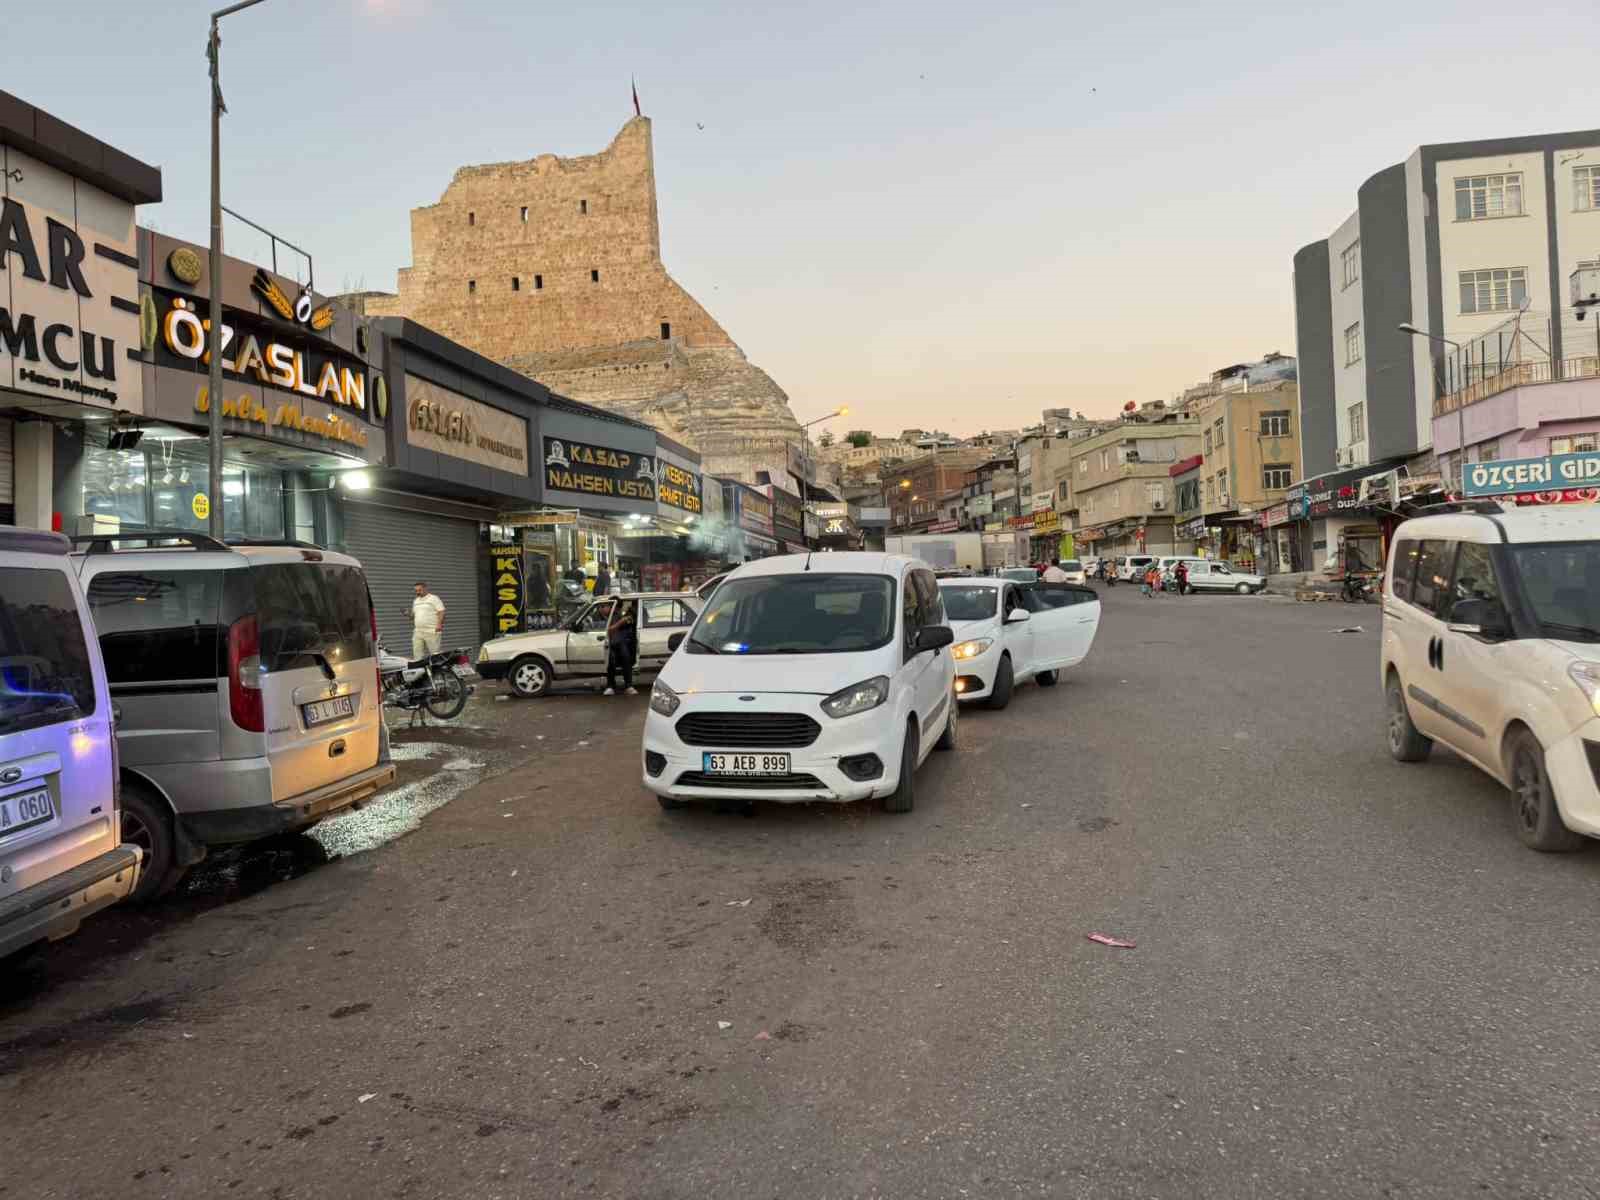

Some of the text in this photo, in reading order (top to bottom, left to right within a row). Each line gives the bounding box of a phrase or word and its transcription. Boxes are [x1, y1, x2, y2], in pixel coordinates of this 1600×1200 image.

[164, 297, 364, 410] ÖZASLAN
[570, 445, 631, 468] KASAP
[549, 470, 653, 499] NAHSEN USTA
[1472, 458, 1552, 489] ÖZÇERİ
[496, 558, 518, 633] KASAP
[710, 755, 786, 770] 63 AEB 899
[18, 793, 48, 821] 060
